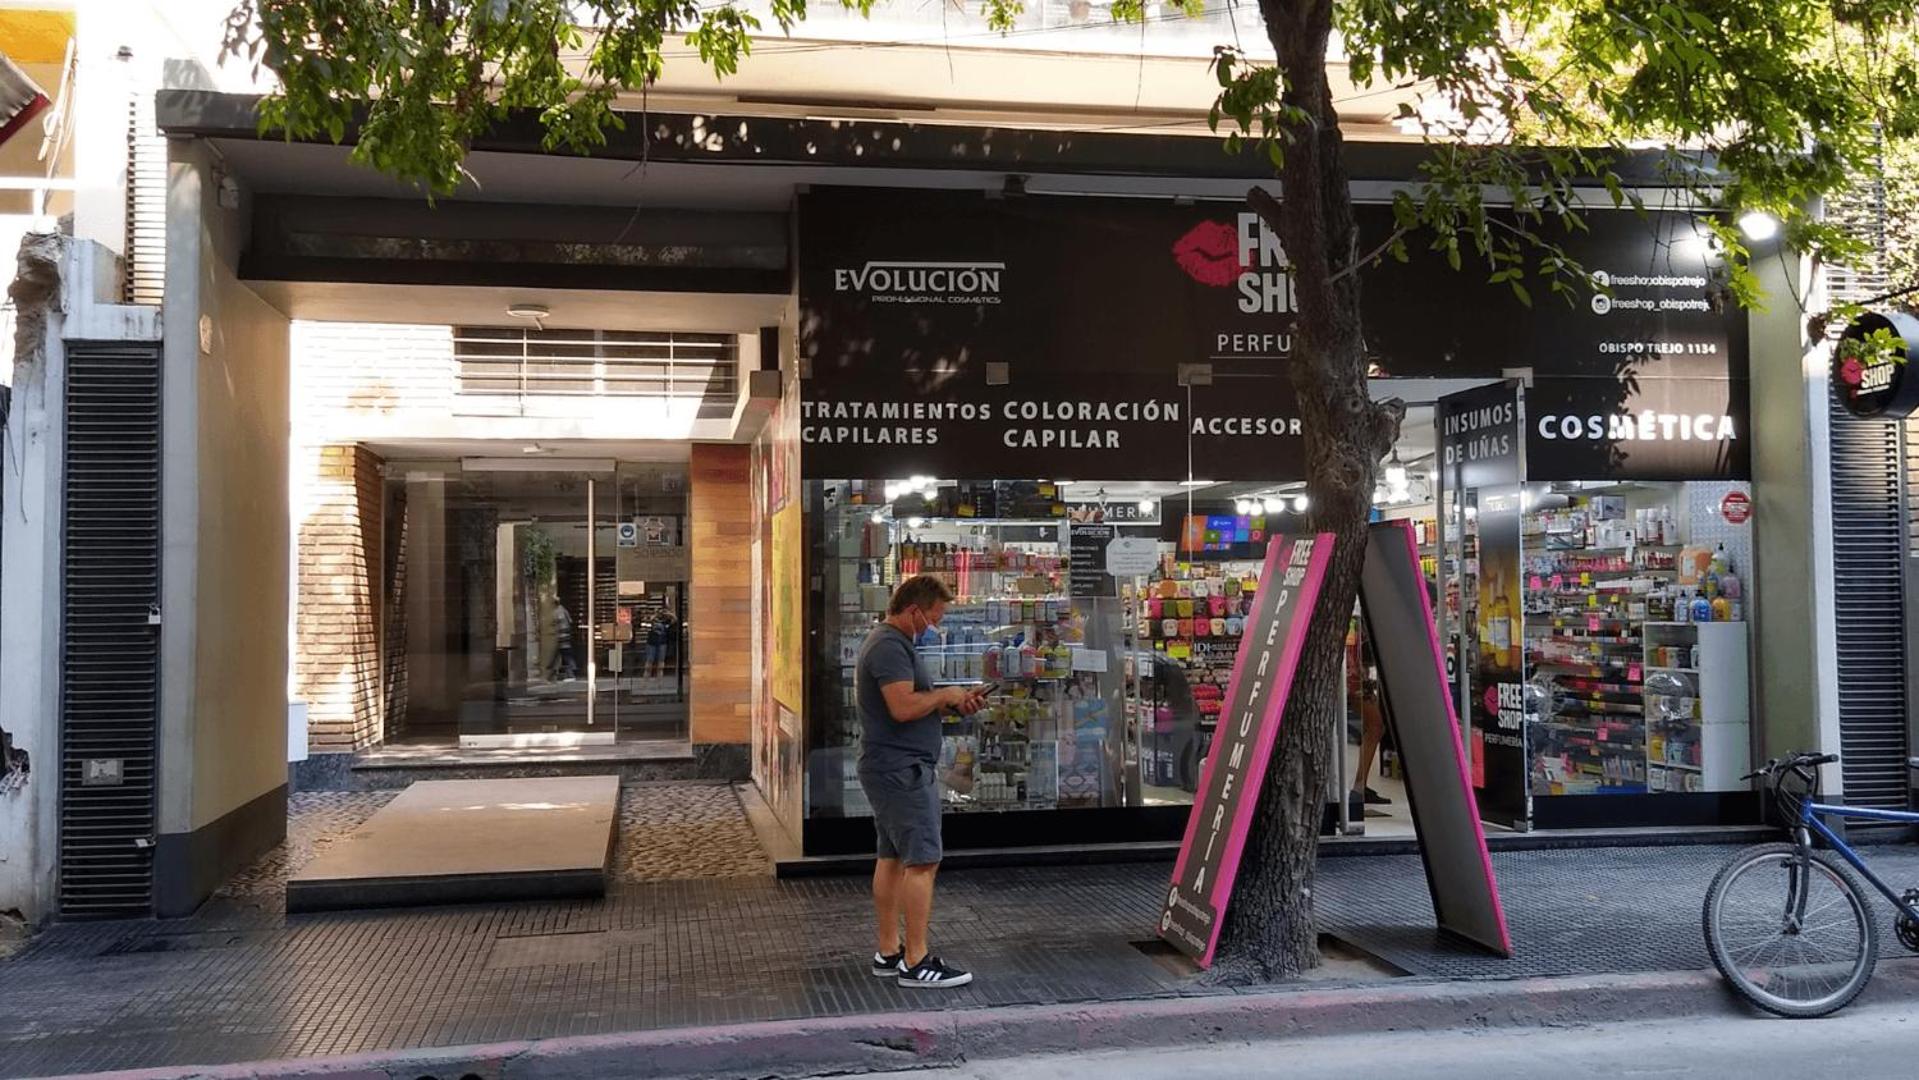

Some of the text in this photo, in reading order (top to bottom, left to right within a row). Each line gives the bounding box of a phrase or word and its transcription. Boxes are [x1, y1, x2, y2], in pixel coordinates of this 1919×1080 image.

[1237, 212, 1289, 267] FR
[834, 261, 1005, 292] EVOLUCIÓN
[871, 295, 1002, 304] PROFESSIONAL COSMETICS
[1237, 271, 1299, 314] SH
[1217, 334, 1291, 352] PERFU
[1599, 343, 1717, 354] OBISPO TREJO 1134
[1861, 364, 1895, 389] SHOP
[801, 401, 992, 421] TRATAMIENTOS
[1002, 399, 1180, 421] COLORACIÓN
[1444, 402, 1513, 437] INSUMOS
[801, 426, 939, 445] CAPILARES
[1191, 417, 1303, 436] ACCESOR
[1538, 409, 1738, 441] COSMÉTICA
[1002, 429, 1121, 449] CAPILAR
[1445, 434, 1509, 465] DE UÑAS
[1290, 539, 1314, 566] FREE
[1283, 567, 1306, 586] SHOP
[1497, 682, 1522, 709] FREE
[1497, 709, 1523, 730] SHOP
